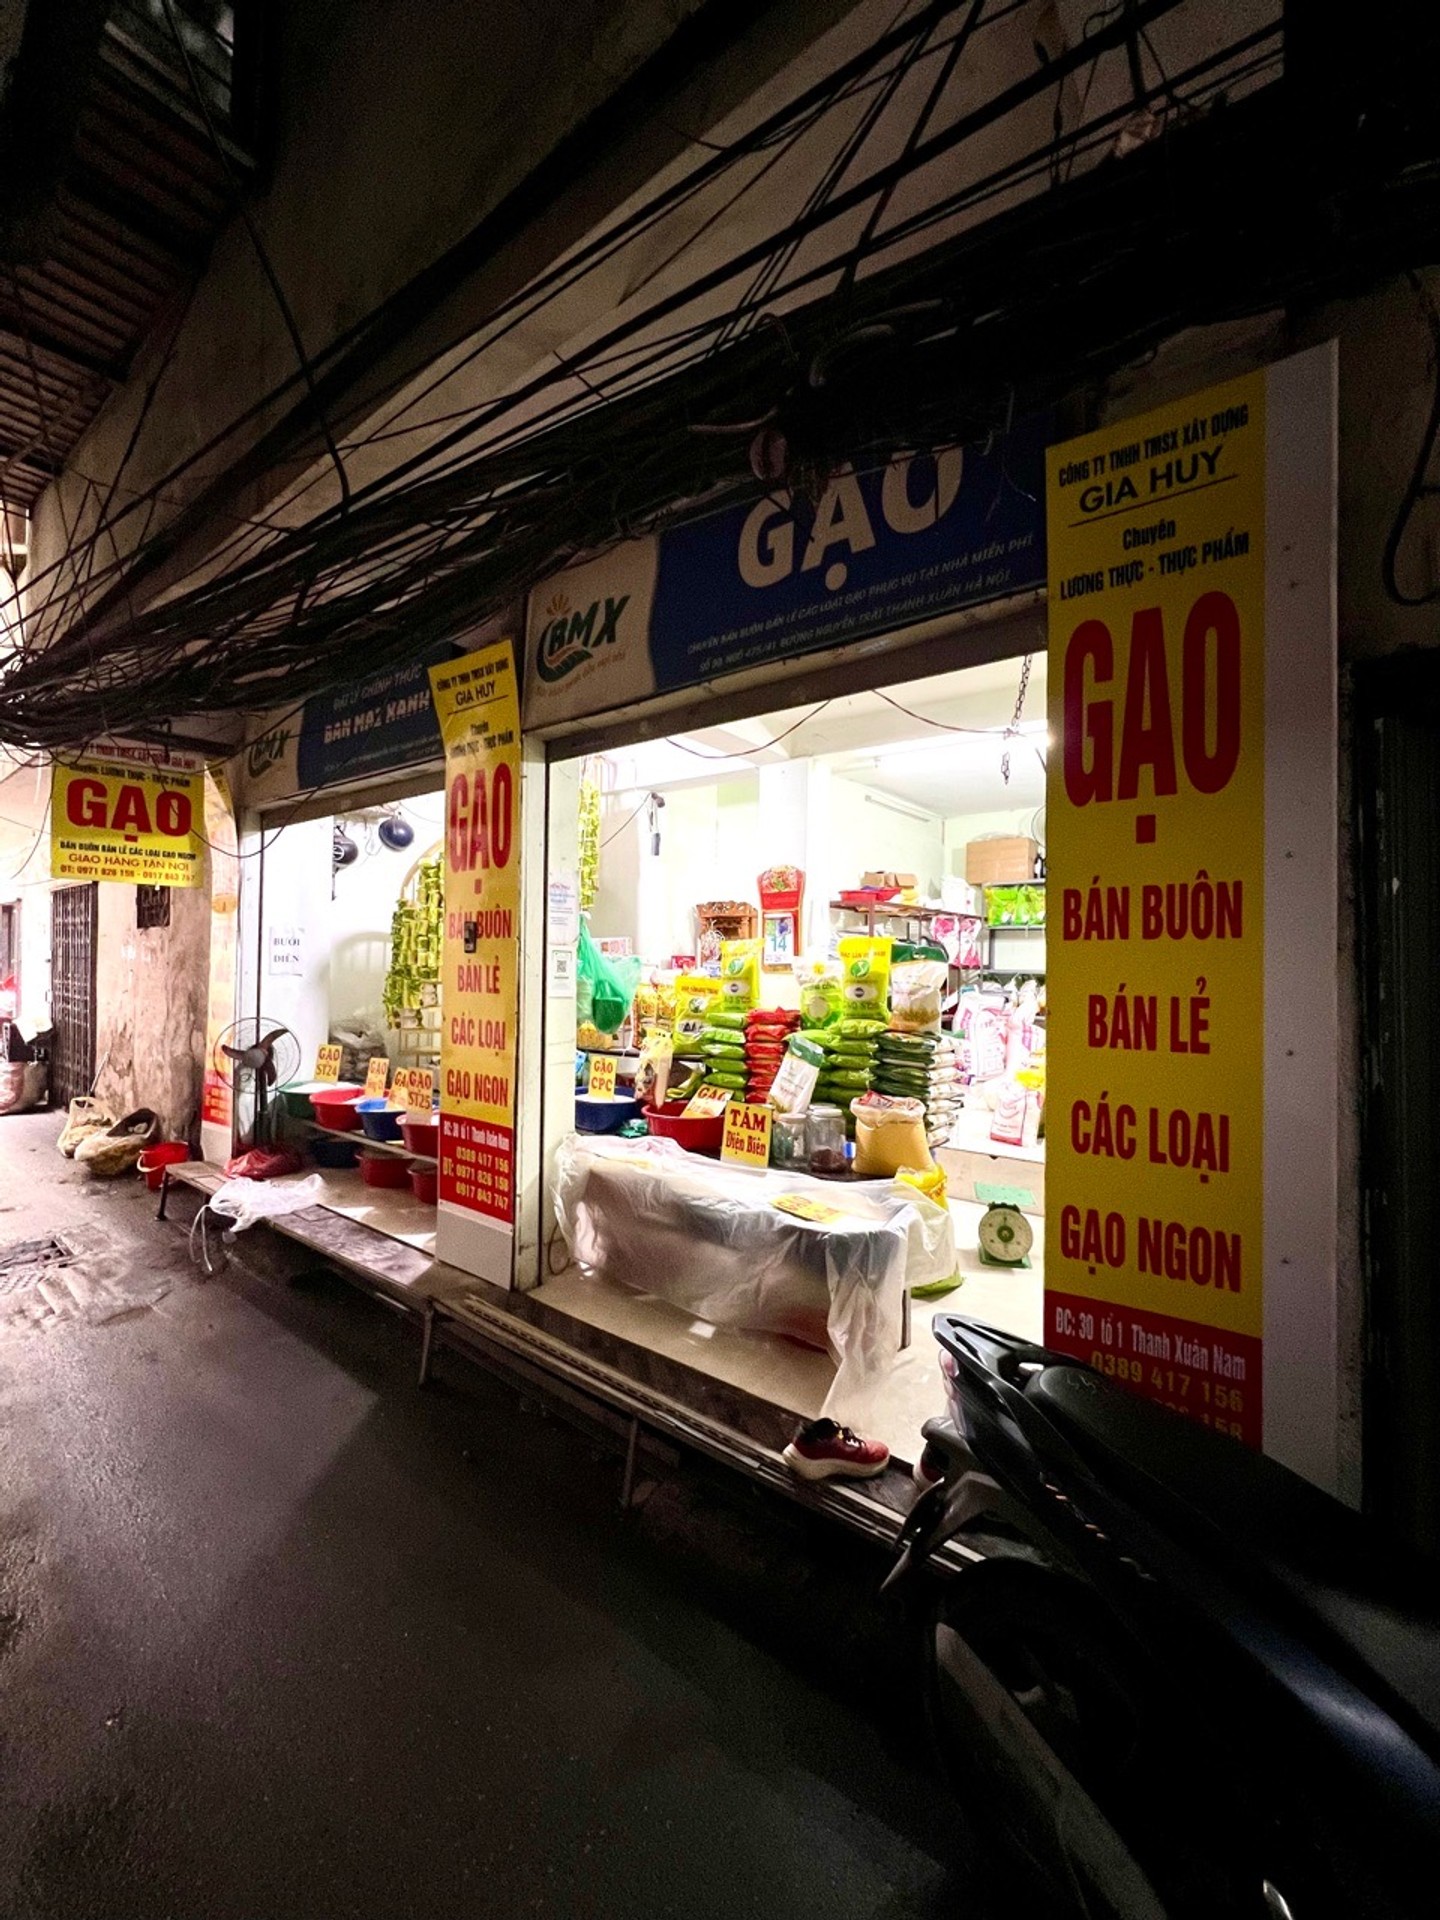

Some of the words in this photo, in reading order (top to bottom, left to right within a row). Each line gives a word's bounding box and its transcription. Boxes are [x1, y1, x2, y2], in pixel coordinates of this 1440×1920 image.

[1058, 461, 1089, 487] CÔNG
[1093, 455, 1106, 476] TY
[1109, 442, 1140, 472] TNHH
[1182, 417, 1208, 447] XÂY
[1211, 403, 1249, 436] DỰNG
[1079, 476, 1138, 513] GIA
[1149, 445, 1223, 493] HUY
[1123, 518, 1176, 551] Chuyên
[1060, 571, 1104, 601] LƯƠNG
[1109, 559, 1144, 588] THỰC
[1159, 545, 1197, 576] THỰC
[1202, 526, 1249, 565] PHẨM
[476, 680, 496, 699] HUY
[1064, 591, 1241, 844] GẠO
[66, 778, 192, 842] GẠO
[451, 762, 512, 895] GẠO
[69, 853, 101, 864] GIAO
[477, 903, 511, 939] BUÔN
[1063, 875, 1130, 941] BÁN
[1142, 869, 1243, 940] BUÔN
[770, 935, 787, 952] 14
[458, 959, 482, 993] BÁN
[486, 955, 501, 994] LẺ
[451, 1012, 474, 1046] CÁC
[478, 1021, 506, 1056] LOẠI
[1088, 982, 1157, 1051] BÁN
[1170, 976, 1210, 1054] LẺ
[316, 1063, 337, 1076] ST24
[318, 1047, 340, 1066] GẠO
[408, 1071, 432, 1092] GẠO
[408, 1091, 430, 1109] ST25
[446, 1069, 471, 1104] GẠO
[474, 1073, 509, 1107] NGON
[591, 1076, 613, 1092] CPC
[726, 1131, 745, 1155] Điện
[746, 1135, 766, 1156] Biên
[1071, 1091, 1136, 1160] CÁC
[1149, 1107, 1229, 1183] LOẠI
[1061, 1204, 1126, 1275] GẠO
[1138, 1217, 1242, 1293] NGON
[1055, 1306, 1076, 1338] ĐC:
[1078, 1312, 1094, 1341] 30
[1116, 1321, 1123, 1348] 1
[1131, 1324, 1171, 1361] Thanh
[1174, 1334, 1209, 1371] Xuân
[1212, 1344, 1247, 1381] Nam
[1091, 1350, 1143, 1384] 0389
[1151, 1366, 1191, 1398] 417
[1201, 1380, 1244, 1413] 156
